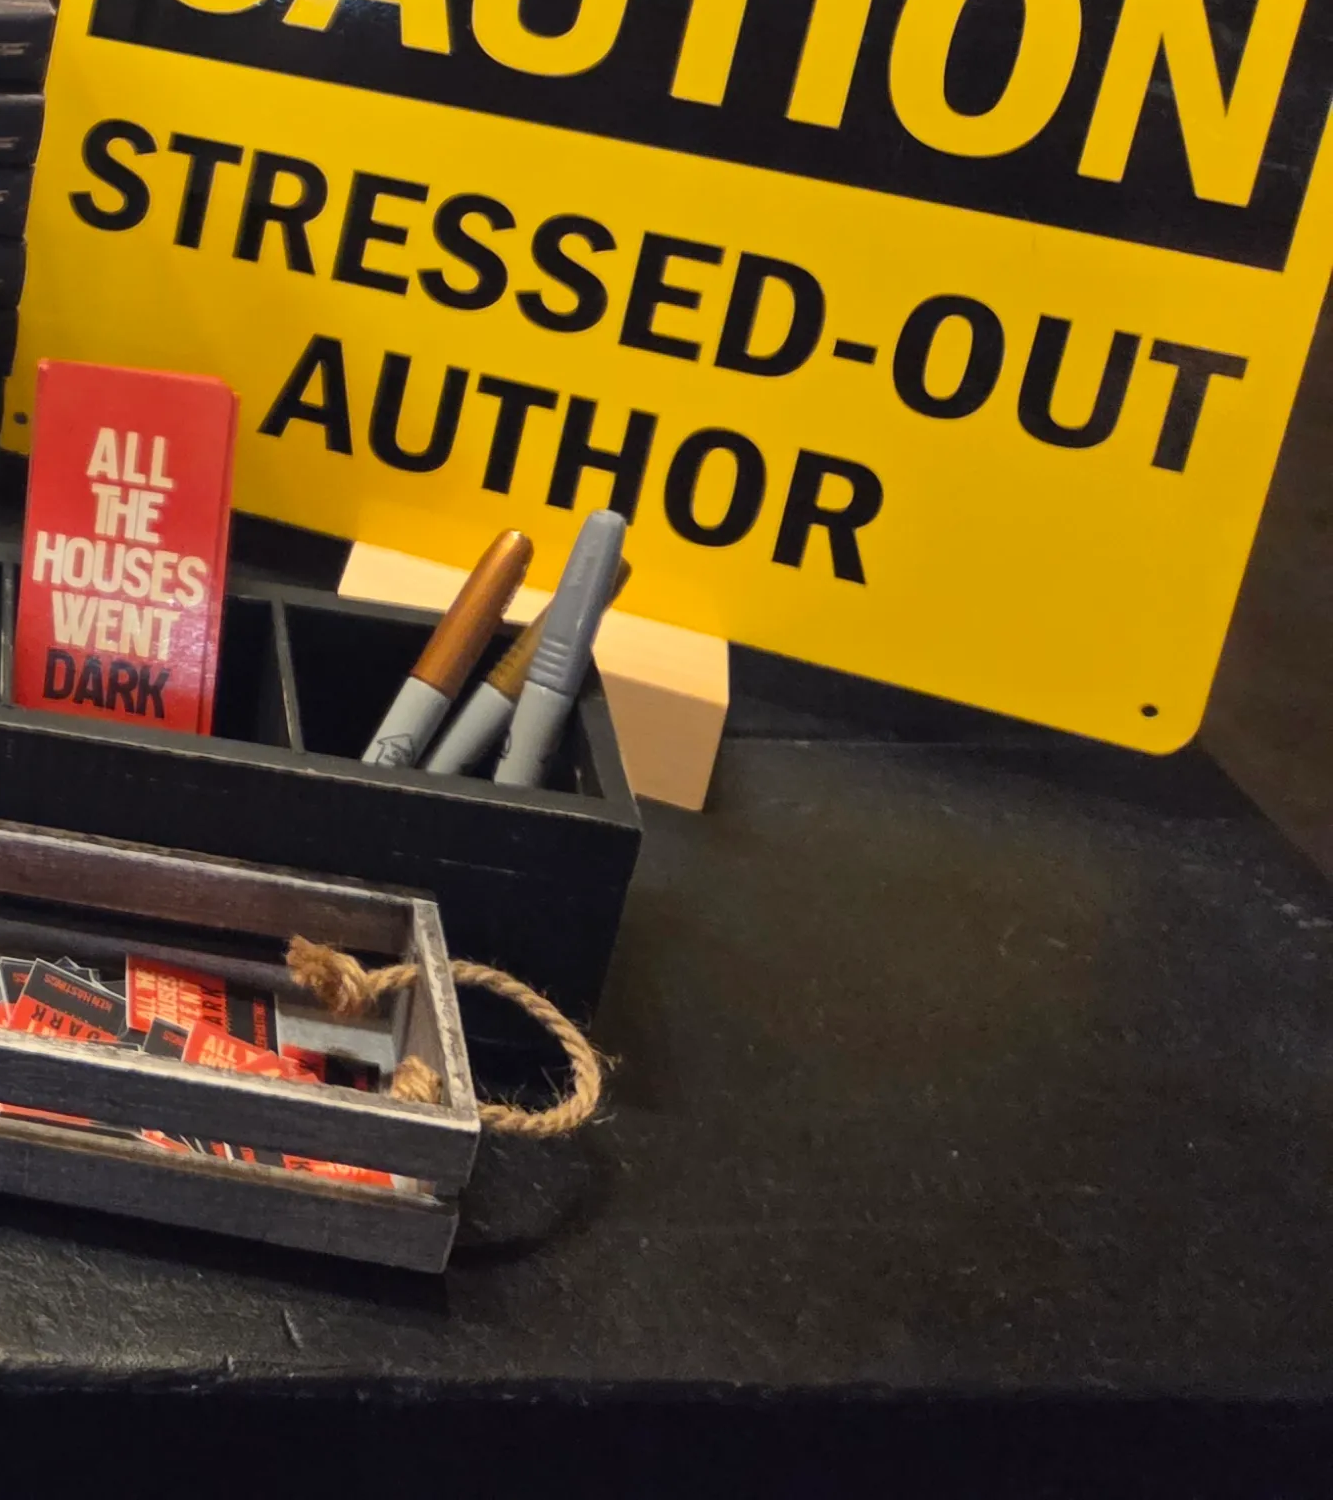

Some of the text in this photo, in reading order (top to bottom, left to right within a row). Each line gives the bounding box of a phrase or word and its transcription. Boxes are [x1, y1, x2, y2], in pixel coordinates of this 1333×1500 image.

[68, 118, 1249, 474] STRESSED-OUT
[85, 426, 175, 489] ALL
[259, 335, 886, 586] AUTHOR
[91, 482, 165, 545] THE
[32, 529, 208, 608] HOUSES
[50, 589, 182, 662] WENT
[42, 648, 172, 720] DARK
